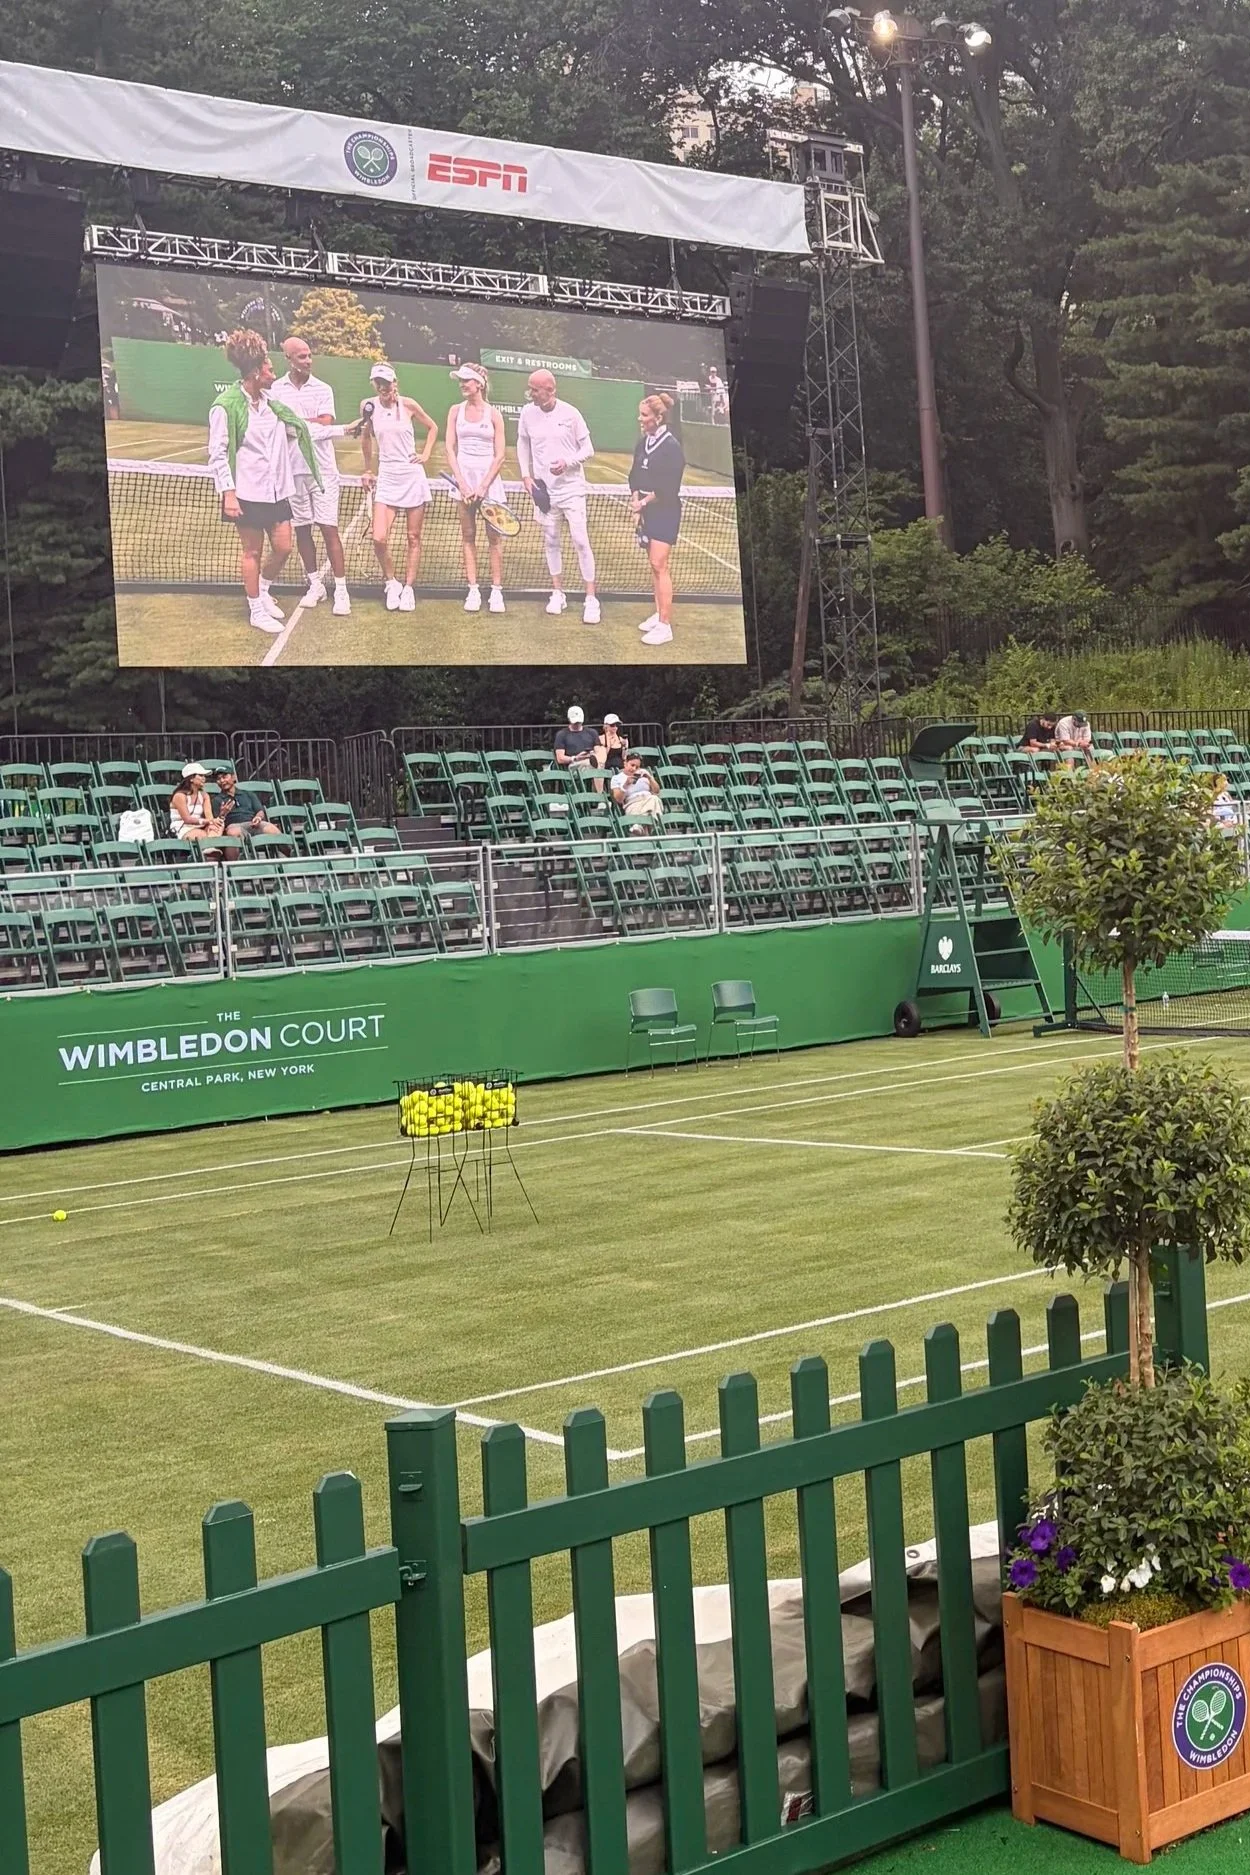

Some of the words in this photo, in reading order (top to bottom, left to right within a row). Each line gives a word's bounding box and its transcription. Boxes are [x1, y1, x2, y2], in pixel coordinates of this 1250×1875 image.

[353, 133, 396, 160] CHAMPIONSHIPS
[354, 170, 390, 185] WIMBLEDON
[428, 153, 528, 193] ESPN
[495, 355, 514, 364] EXIT
[518, 357, 523, 365] &
[525, 358, 577, 371] RESTROOMS
[930, 963, 962, 974] BARCLAYS
[216, 1011, 241, 1022] THE
[58, 1026, 272, 1071] WIMBLEDON
[280, 1015, 385, 1048] COURT
[141, 1077, 202, 1092] CENTRAL
[206, 1072, 244, 1085] PARK,
[248, 1068, 276, 1081] NEW
[281, 1064, 315, 1076] YORK
[1176, 1704, 1186, 1728] THE
[1183, 1668, 1243, 1701] CHAMPIONSHIPS
[1189, 1729, 1238, 1764] WIMBLEDON
